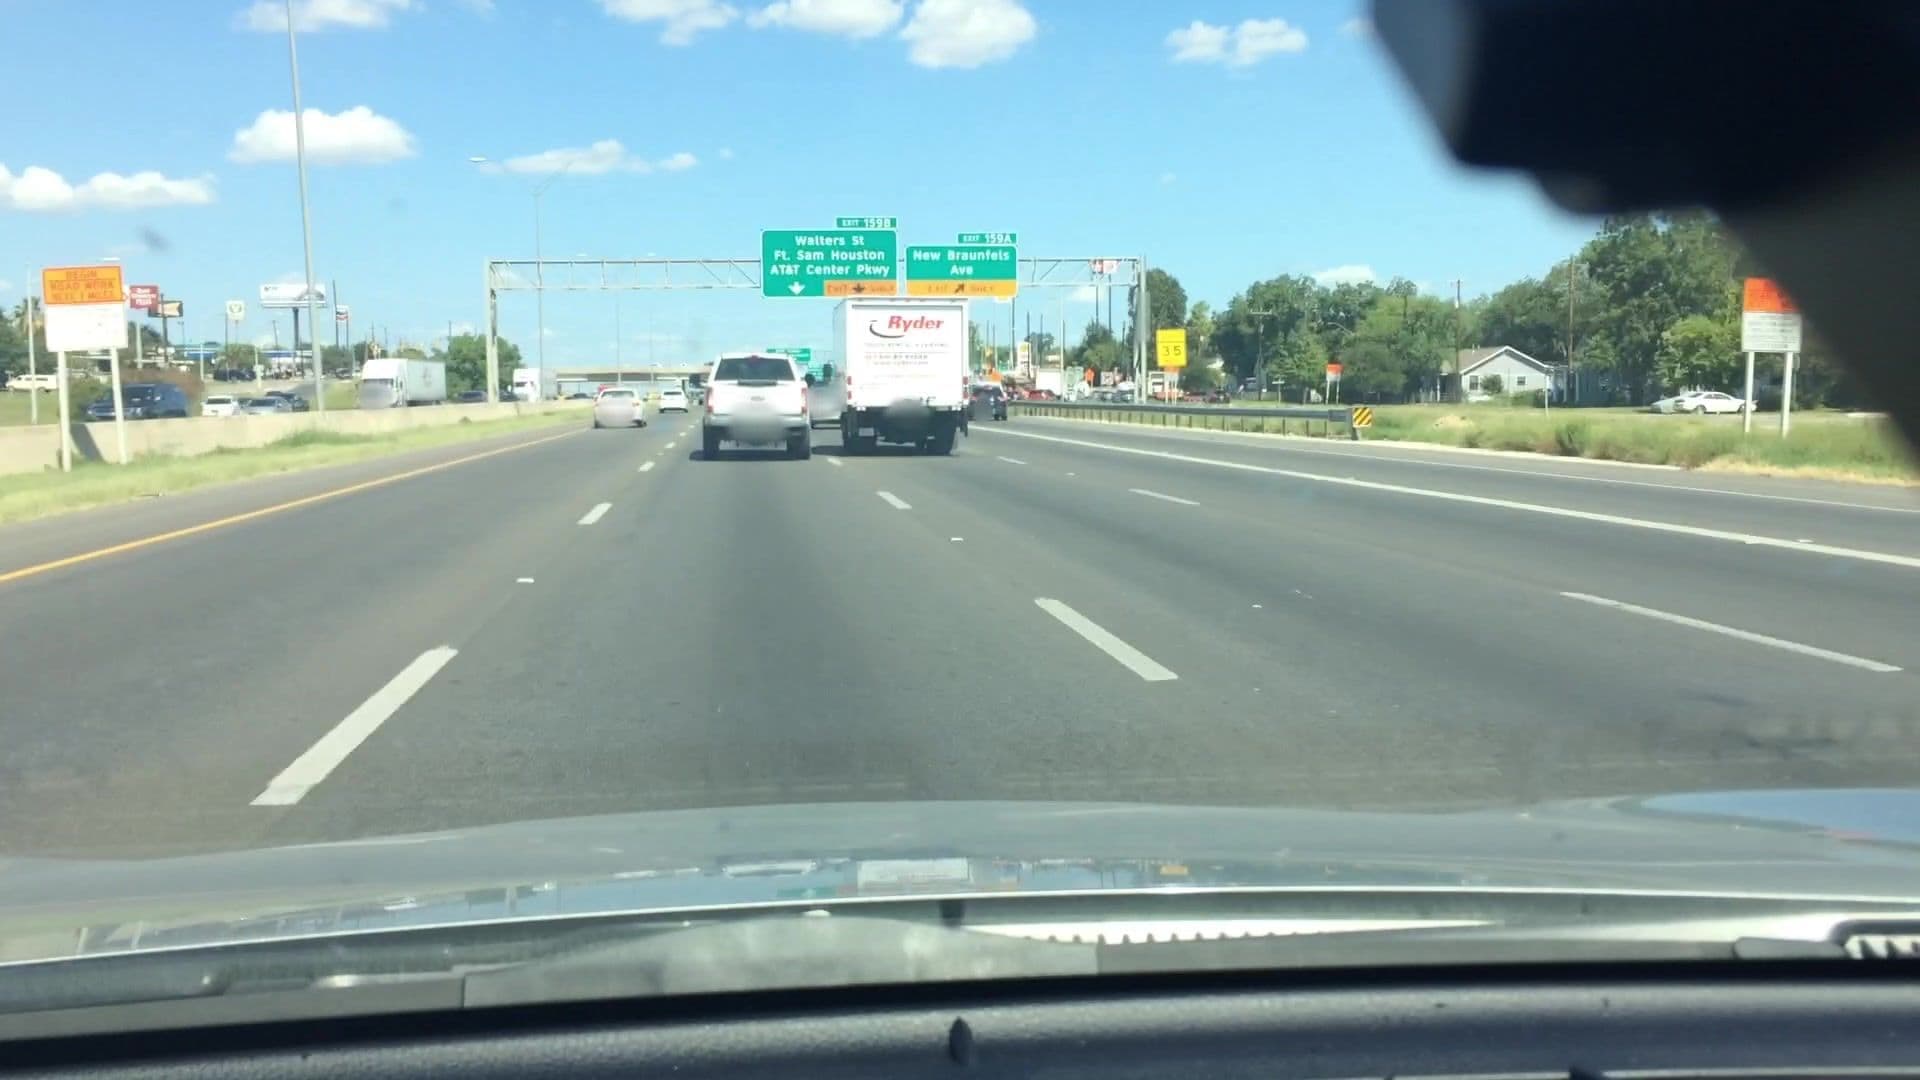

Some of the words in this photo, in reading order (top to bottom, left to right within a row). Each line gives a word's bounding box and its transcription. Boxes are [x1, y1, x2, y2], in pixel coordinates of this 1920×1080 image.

[842, 219, 859, 227] EXIT
[863, 218, 892, 228] 159B
[794, 235, 846, 246] Walters
[851, 235, 865, 246] St
[984, 234, 1012, 243] 159A
[773, 250, 791, 260] Ft.
[796, 250, 825, 260] Sam
[831, 249, 885, 260] Houston
[912, 250, 941, 261] New
[947, 250, 1010, 261] Braunfels
[770, 265, 801, 275] AT&T
[806, 265, 850, 275] Center
[856, 265, 890, 277] Pkwy
[950, 265, 974, 275] Ave
[888, 315, 945, 333] Ryder
[1162, 345, 1182, 357] 35
